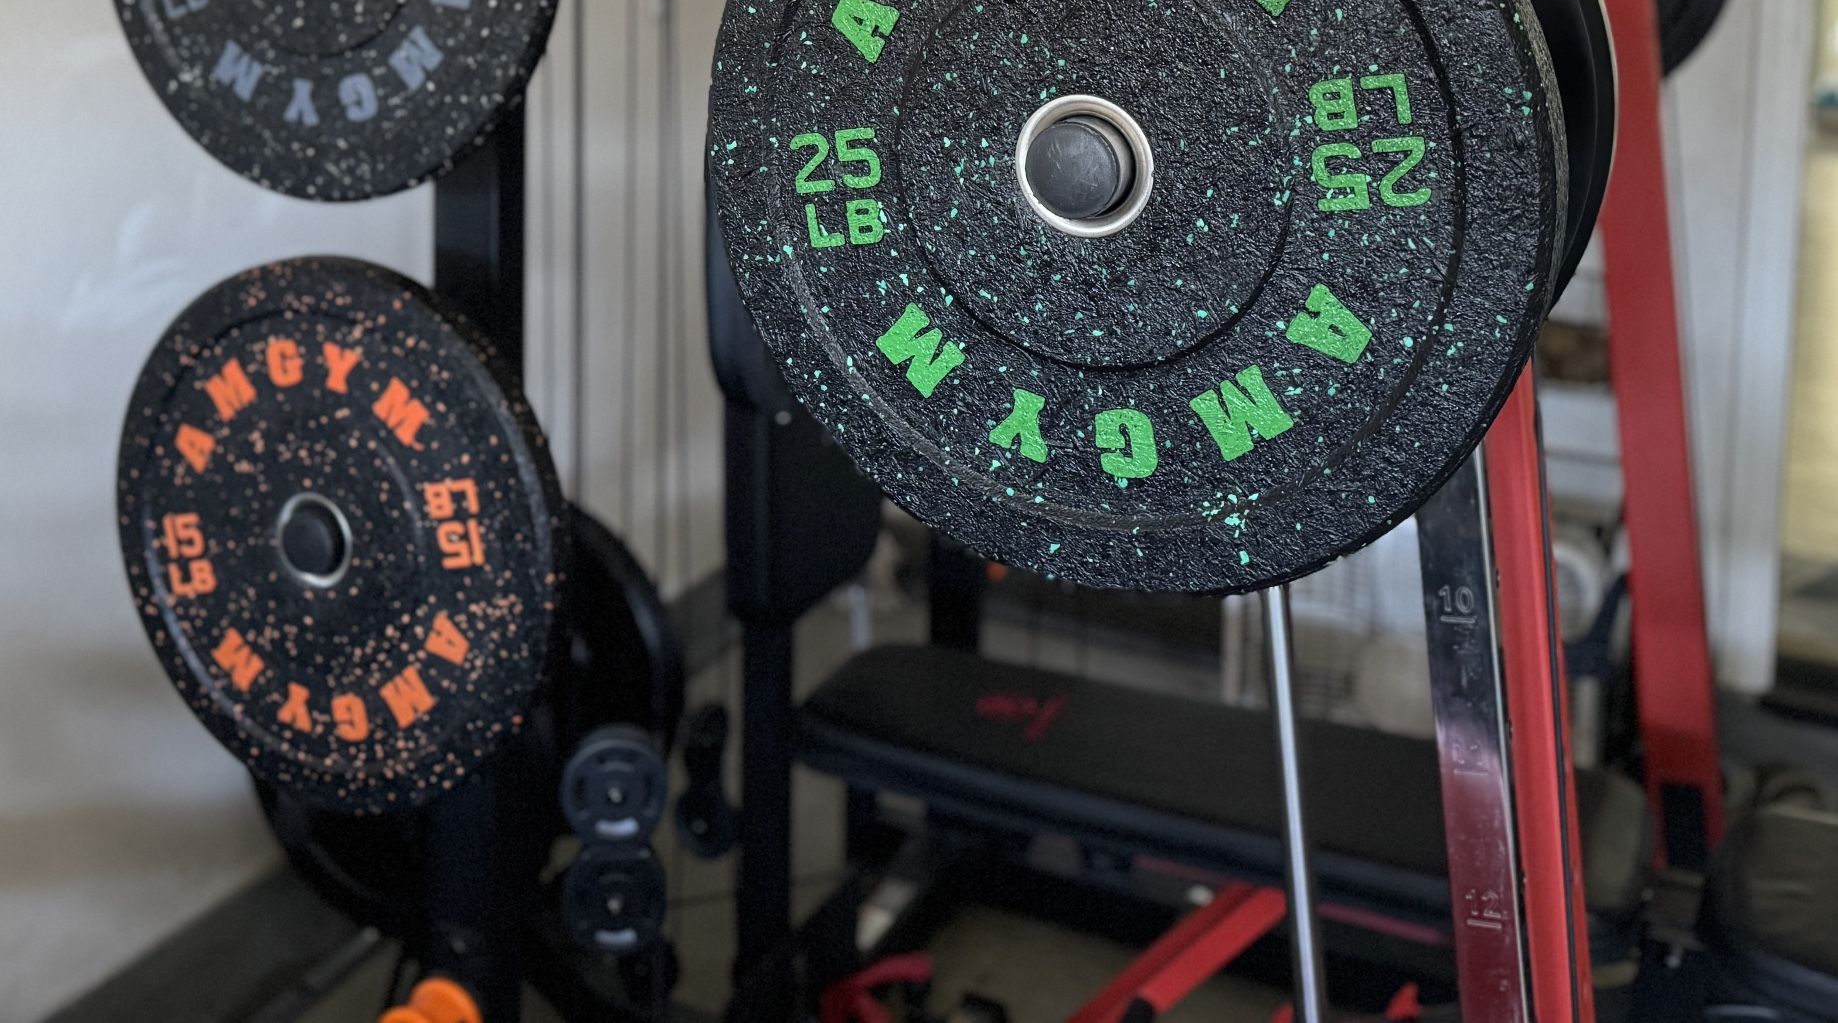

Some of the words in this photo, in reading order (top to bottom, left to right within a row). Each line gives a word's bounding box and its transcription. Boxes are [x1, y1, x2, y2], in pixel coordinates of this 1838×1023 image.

[1310, 74, 1412, 131] LB
[790, 128, 882, 194] 25
[1310, 136, 1433, 213] 25
[807, 199, 885, 249] LB
[424, 478, 480, 519] LB
[163, 512, 205, 560] 15
[436, 518, 485, 570] 15
[168, 558, 217, 596] LB
[1438, 585, 1474, 614] 10
